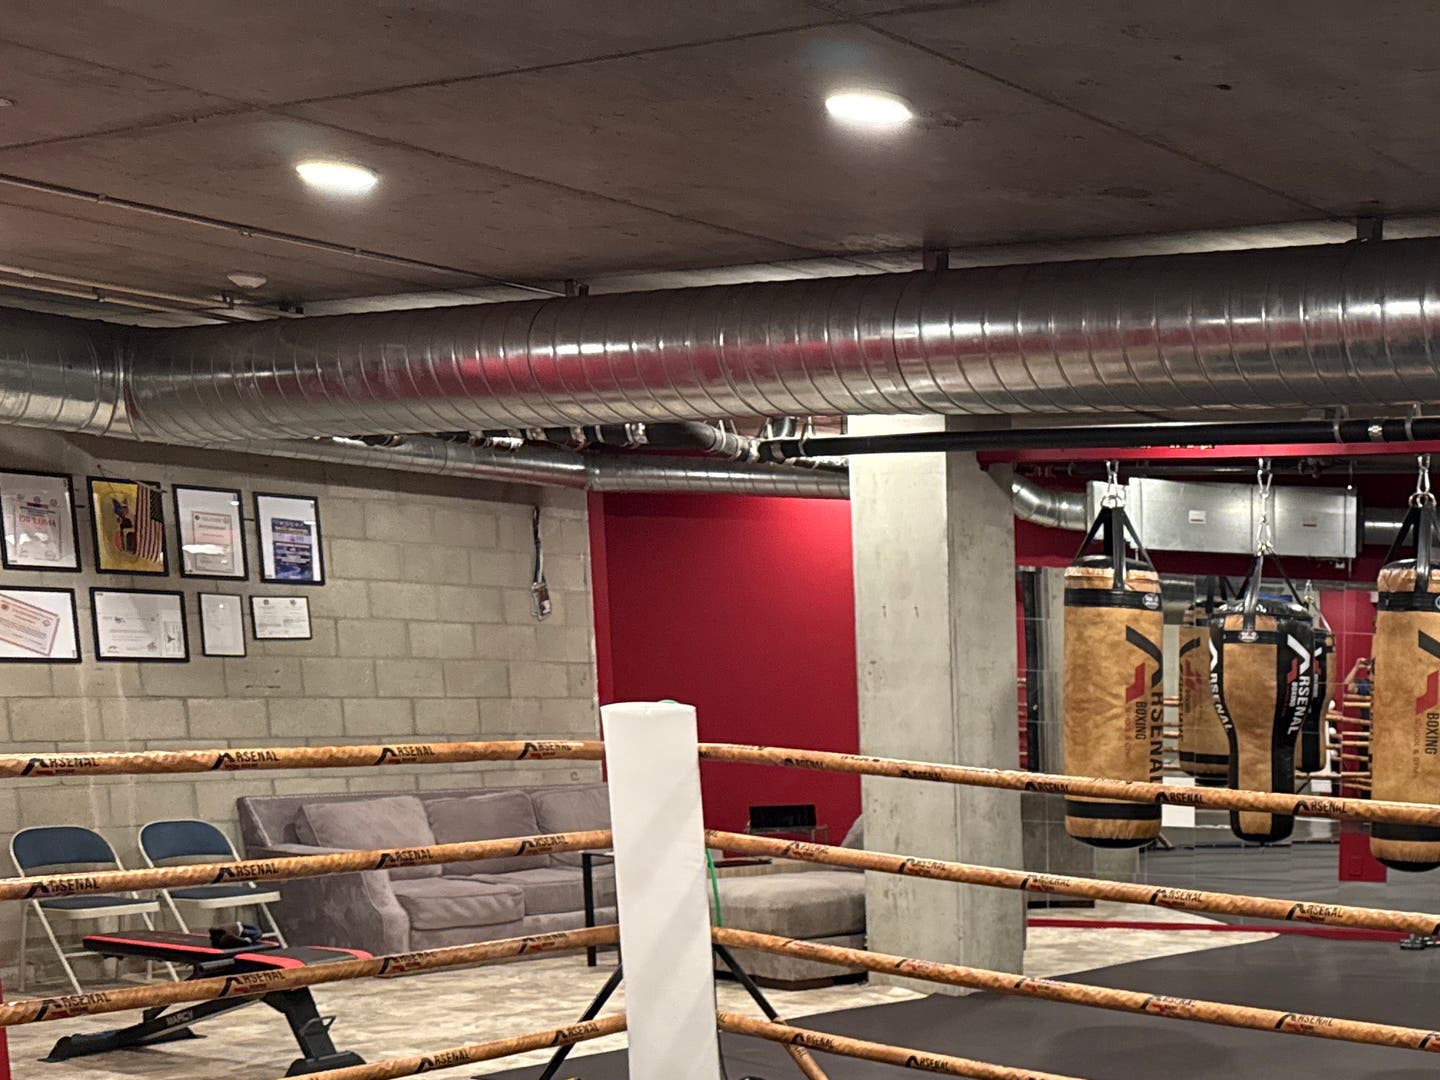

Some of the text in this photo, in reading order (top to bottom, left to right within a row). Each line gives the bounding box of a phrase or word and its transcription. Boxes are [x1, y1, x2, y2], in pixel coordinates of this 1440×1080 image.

[1287, 634, 1311, 735] ARSENAL
[1135, 701, 1147, 740] BOXING
[1425, 712, 1440, 755] BOXING
[211, 751, 281, 770] ARSENAL
[374, 745, 435, 766] ARSENAL
[212, 863, 281, 884] ARSENAL
[414, 1048, 471, 1074] ARSENAL
